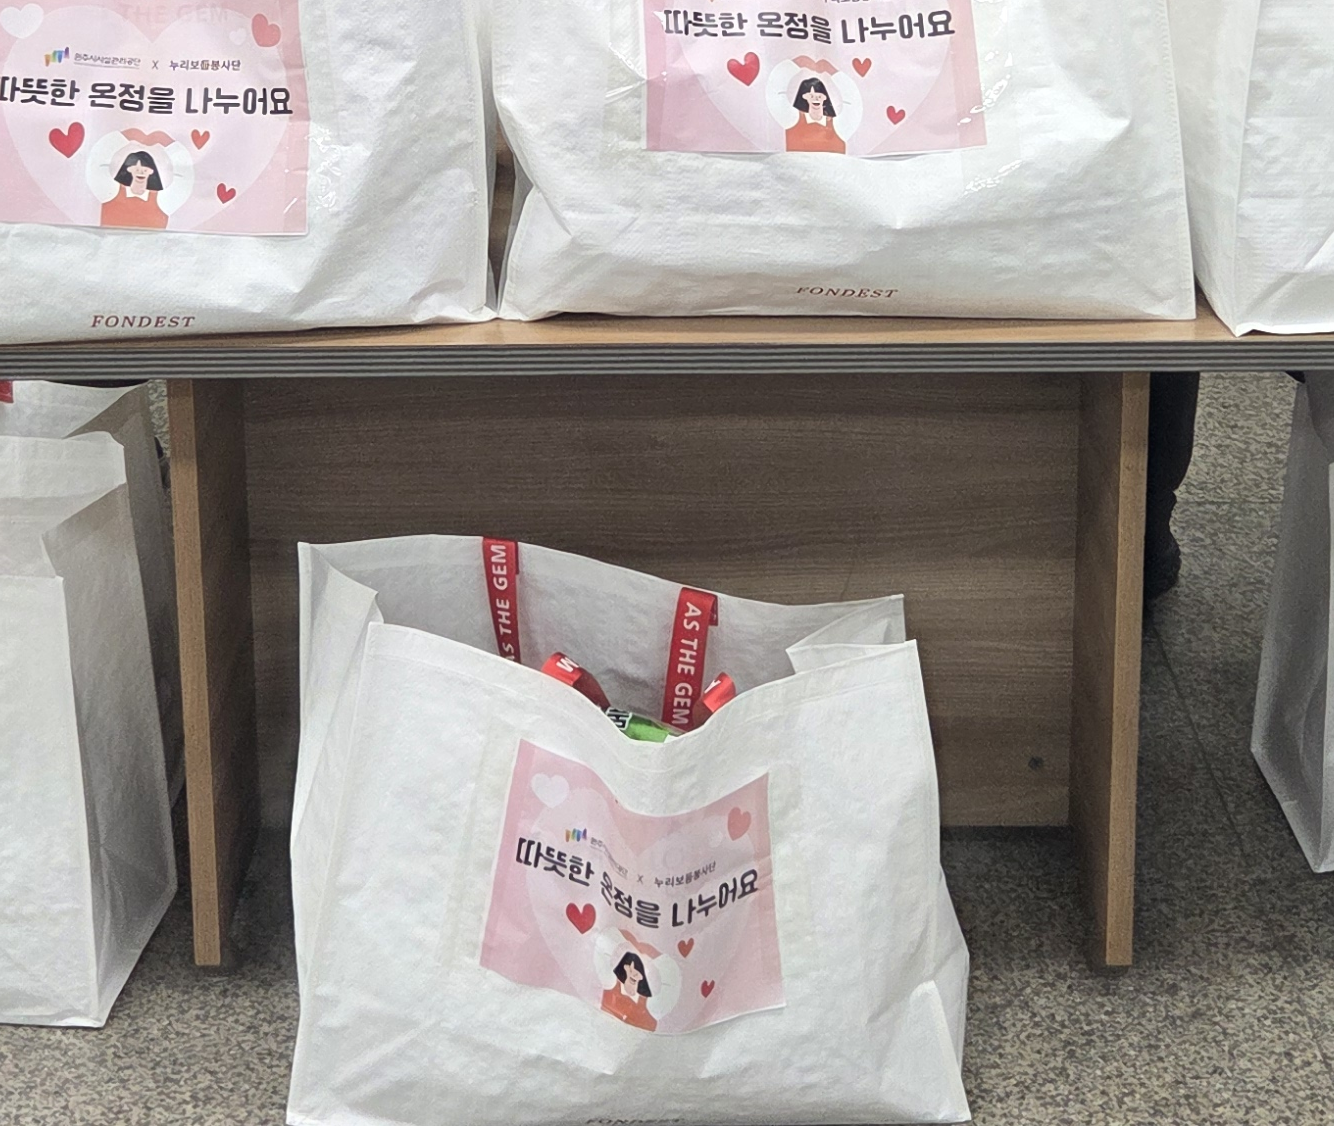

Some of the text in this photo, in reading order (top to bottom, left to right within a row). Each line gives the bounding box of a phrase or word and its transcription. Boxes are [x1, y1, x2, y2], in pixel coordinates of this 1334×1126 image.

[663, 8, 956, 45] 따뜻한 온정을 나누어요
[87, 82, 176, 116] 온정을
[184, 86, 294, 116] 나누어요
[796, 286, 899, 299] FONDEST
[91, 315, 196, 329] FONDEST
[490, 544, 508, 591] GEM
[496, 597, 512, 636] THE
[671, 601, 702, 724] AS THE GEM
[515, 837, 595, 888] 따뜻한
[600, 871, 662, 929] 온정을
[671, 868, 759, 927] 나누어요
